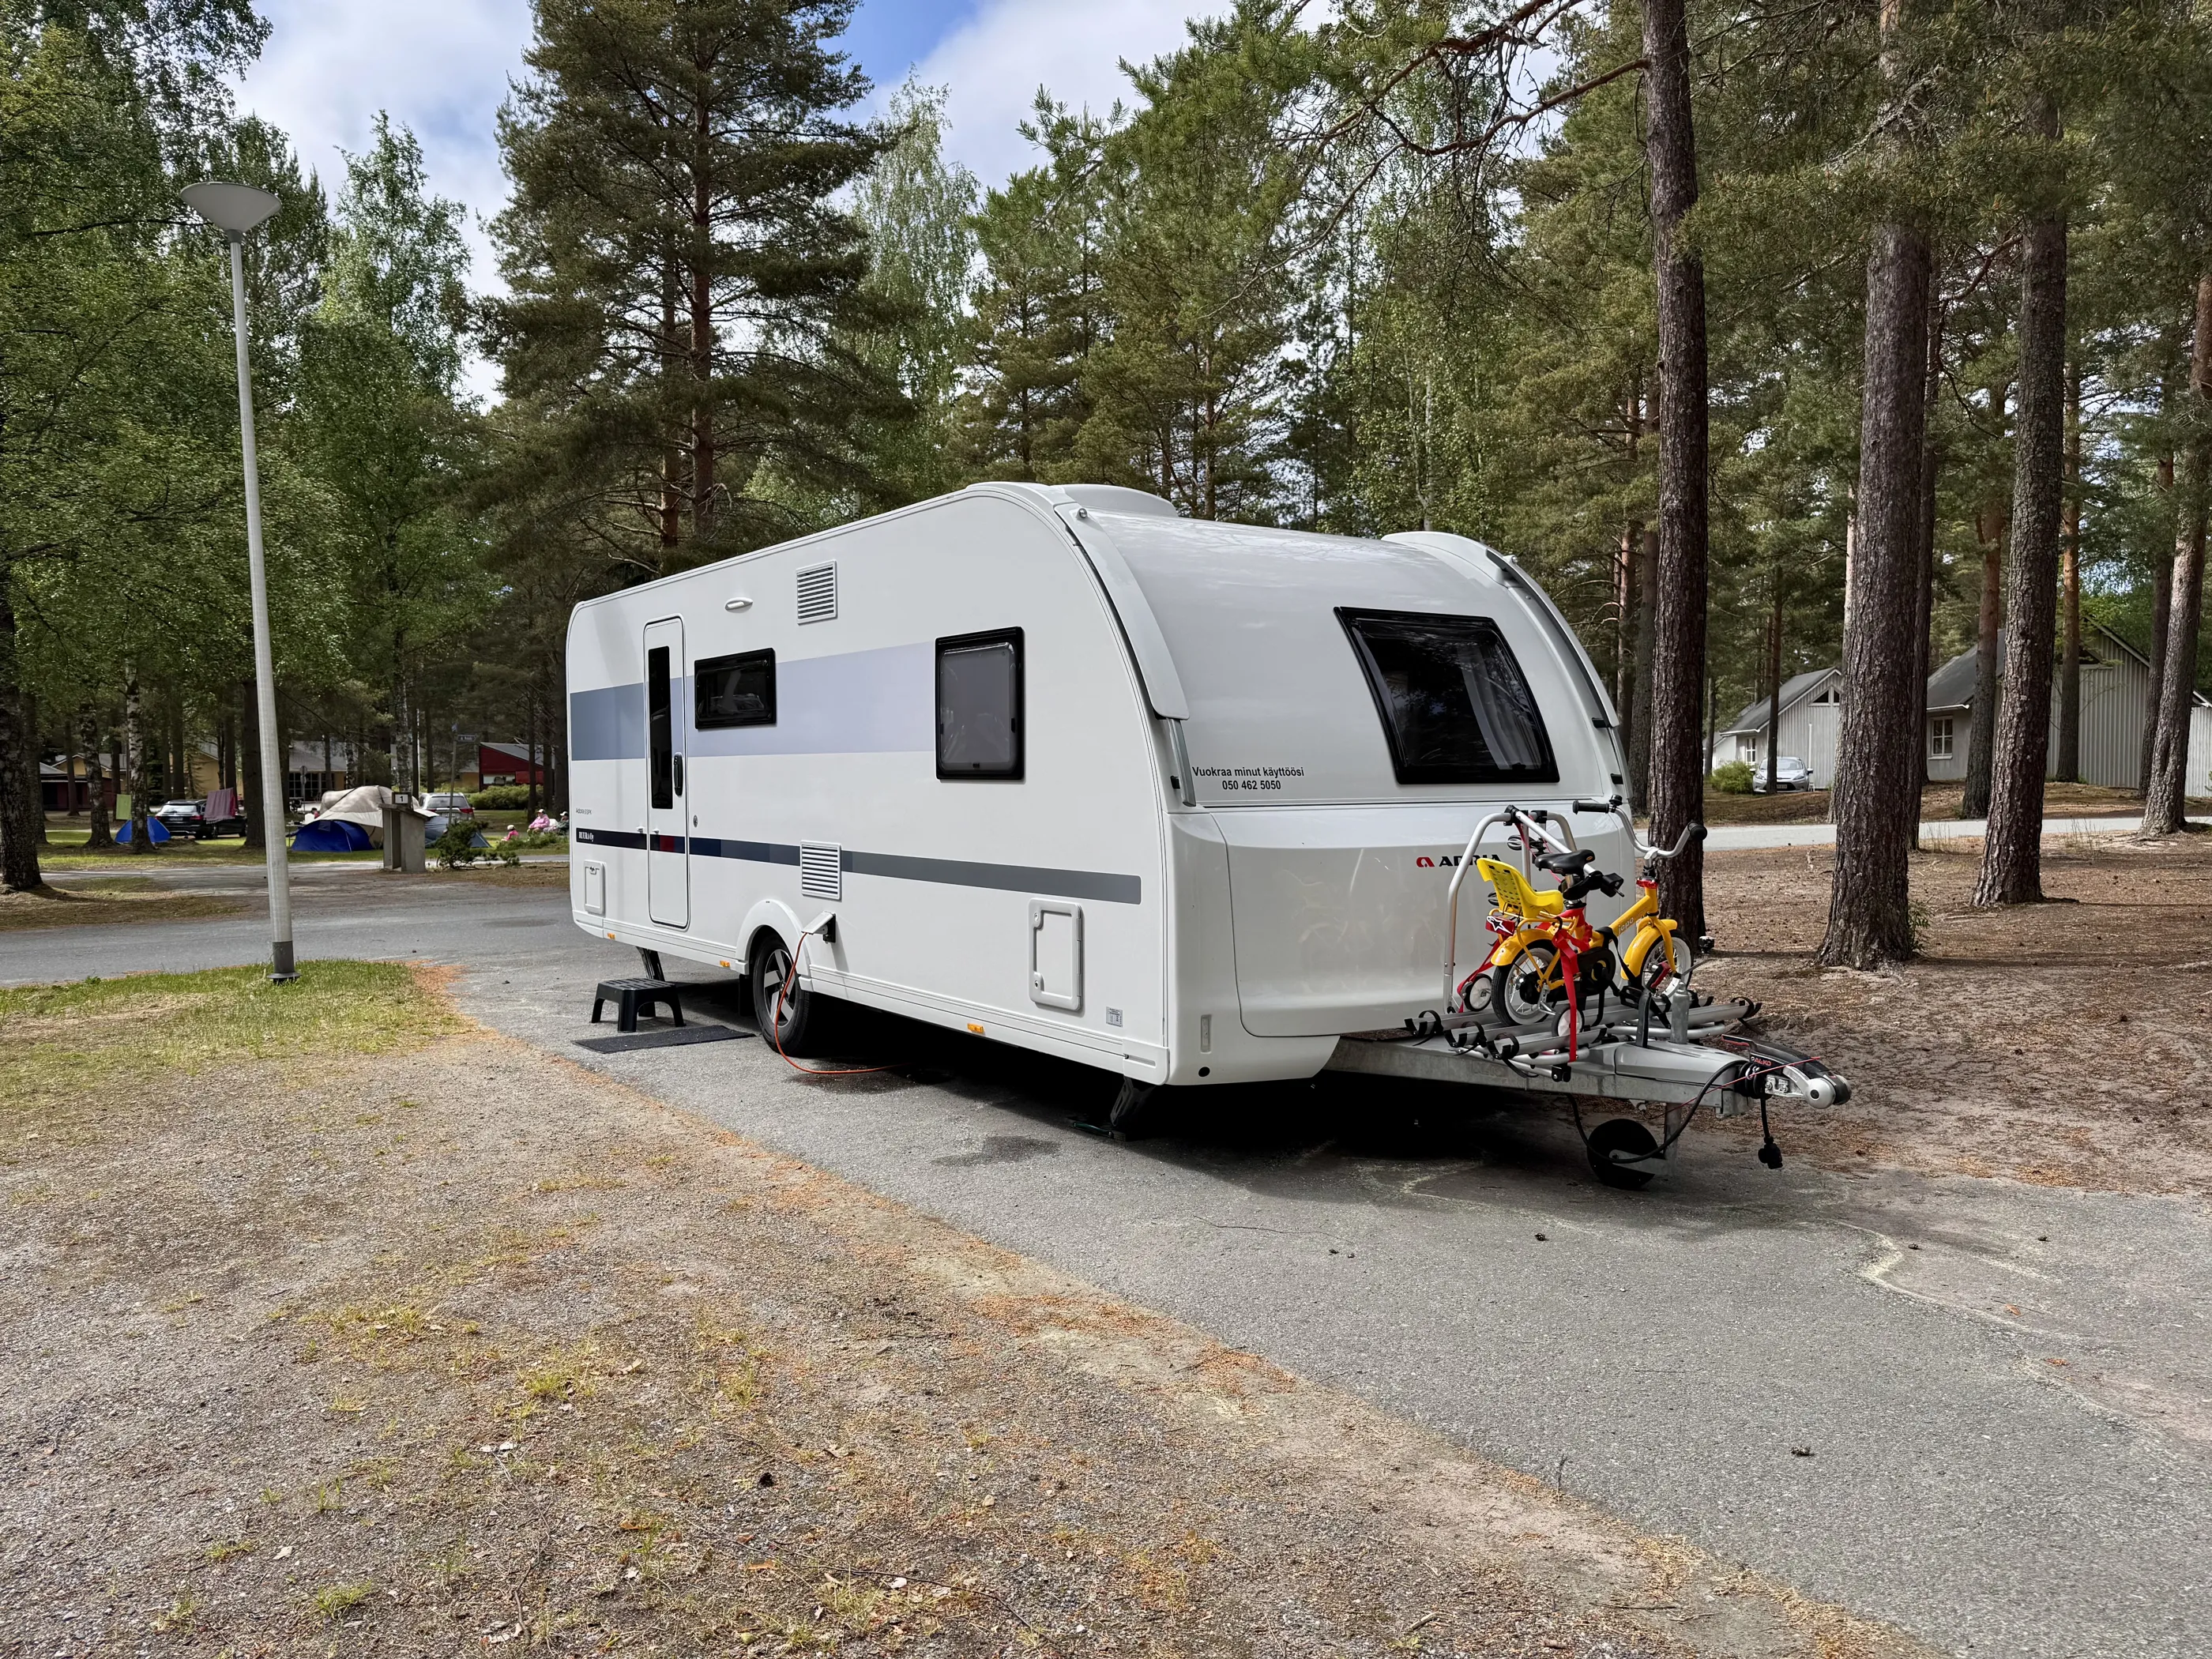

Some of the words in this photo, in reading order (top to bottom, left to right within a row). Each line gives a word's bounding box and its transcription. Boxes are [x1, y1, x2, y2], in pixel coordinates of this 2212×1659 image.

[1192, 767, 1232, 777] Vuokraa
[1235, 767, 1261, 777] minut
[1264, 767, 1304, 778] käyttöösi
[1222, 781, 1239, 790] 050
[1241, 781, 1258, 790] 462
[1260, 781, 1281, 790] 5050
